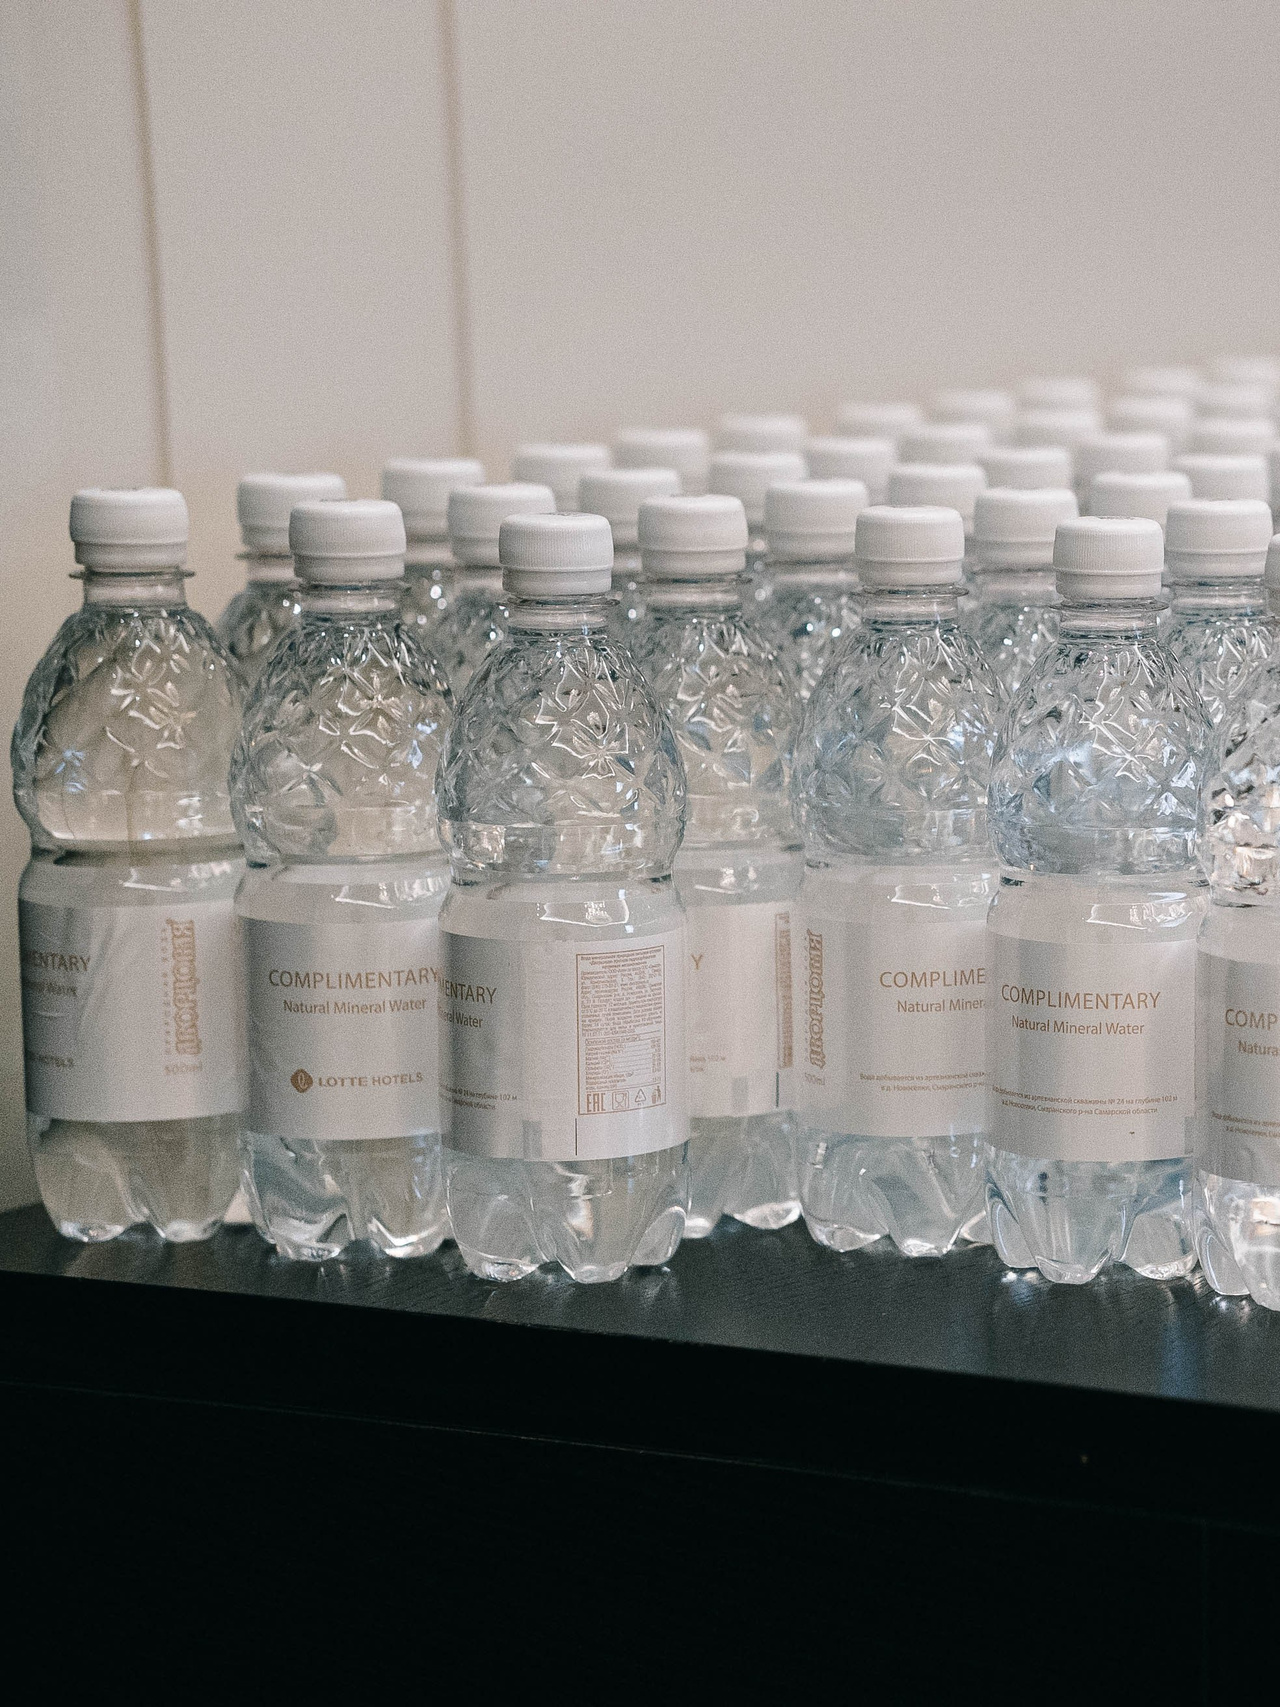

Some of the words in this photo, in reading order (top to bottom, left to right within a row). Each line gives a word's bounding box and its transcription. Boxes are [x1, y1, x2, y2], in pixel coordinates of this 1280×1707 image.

[268, 966, 440, 989] COMPLIMENTARY
[880, 968, 986, 988] COMPLIME
[897, 998, 945, 1013] Natural
[949, 998, 987, 1012] Miner
[1001, 984, 1161, 1010] COMPLIMENTARY
[283, 999, 330, 1015] Natural
[333, 1000, 386, 1015] Mineral
[389, 998, 427, 1012] Water
[455, 1011, 484, 1028] Water
[1011, 1015, 1050, 1033] Natural
[1053, 1020, 1102, 1035] Mineral
[1105, 1022, 1145, 1035] Water
[318, 1075, 368, 1087] LOTTE
[371, 1071, 424, 1087] HOTELS
